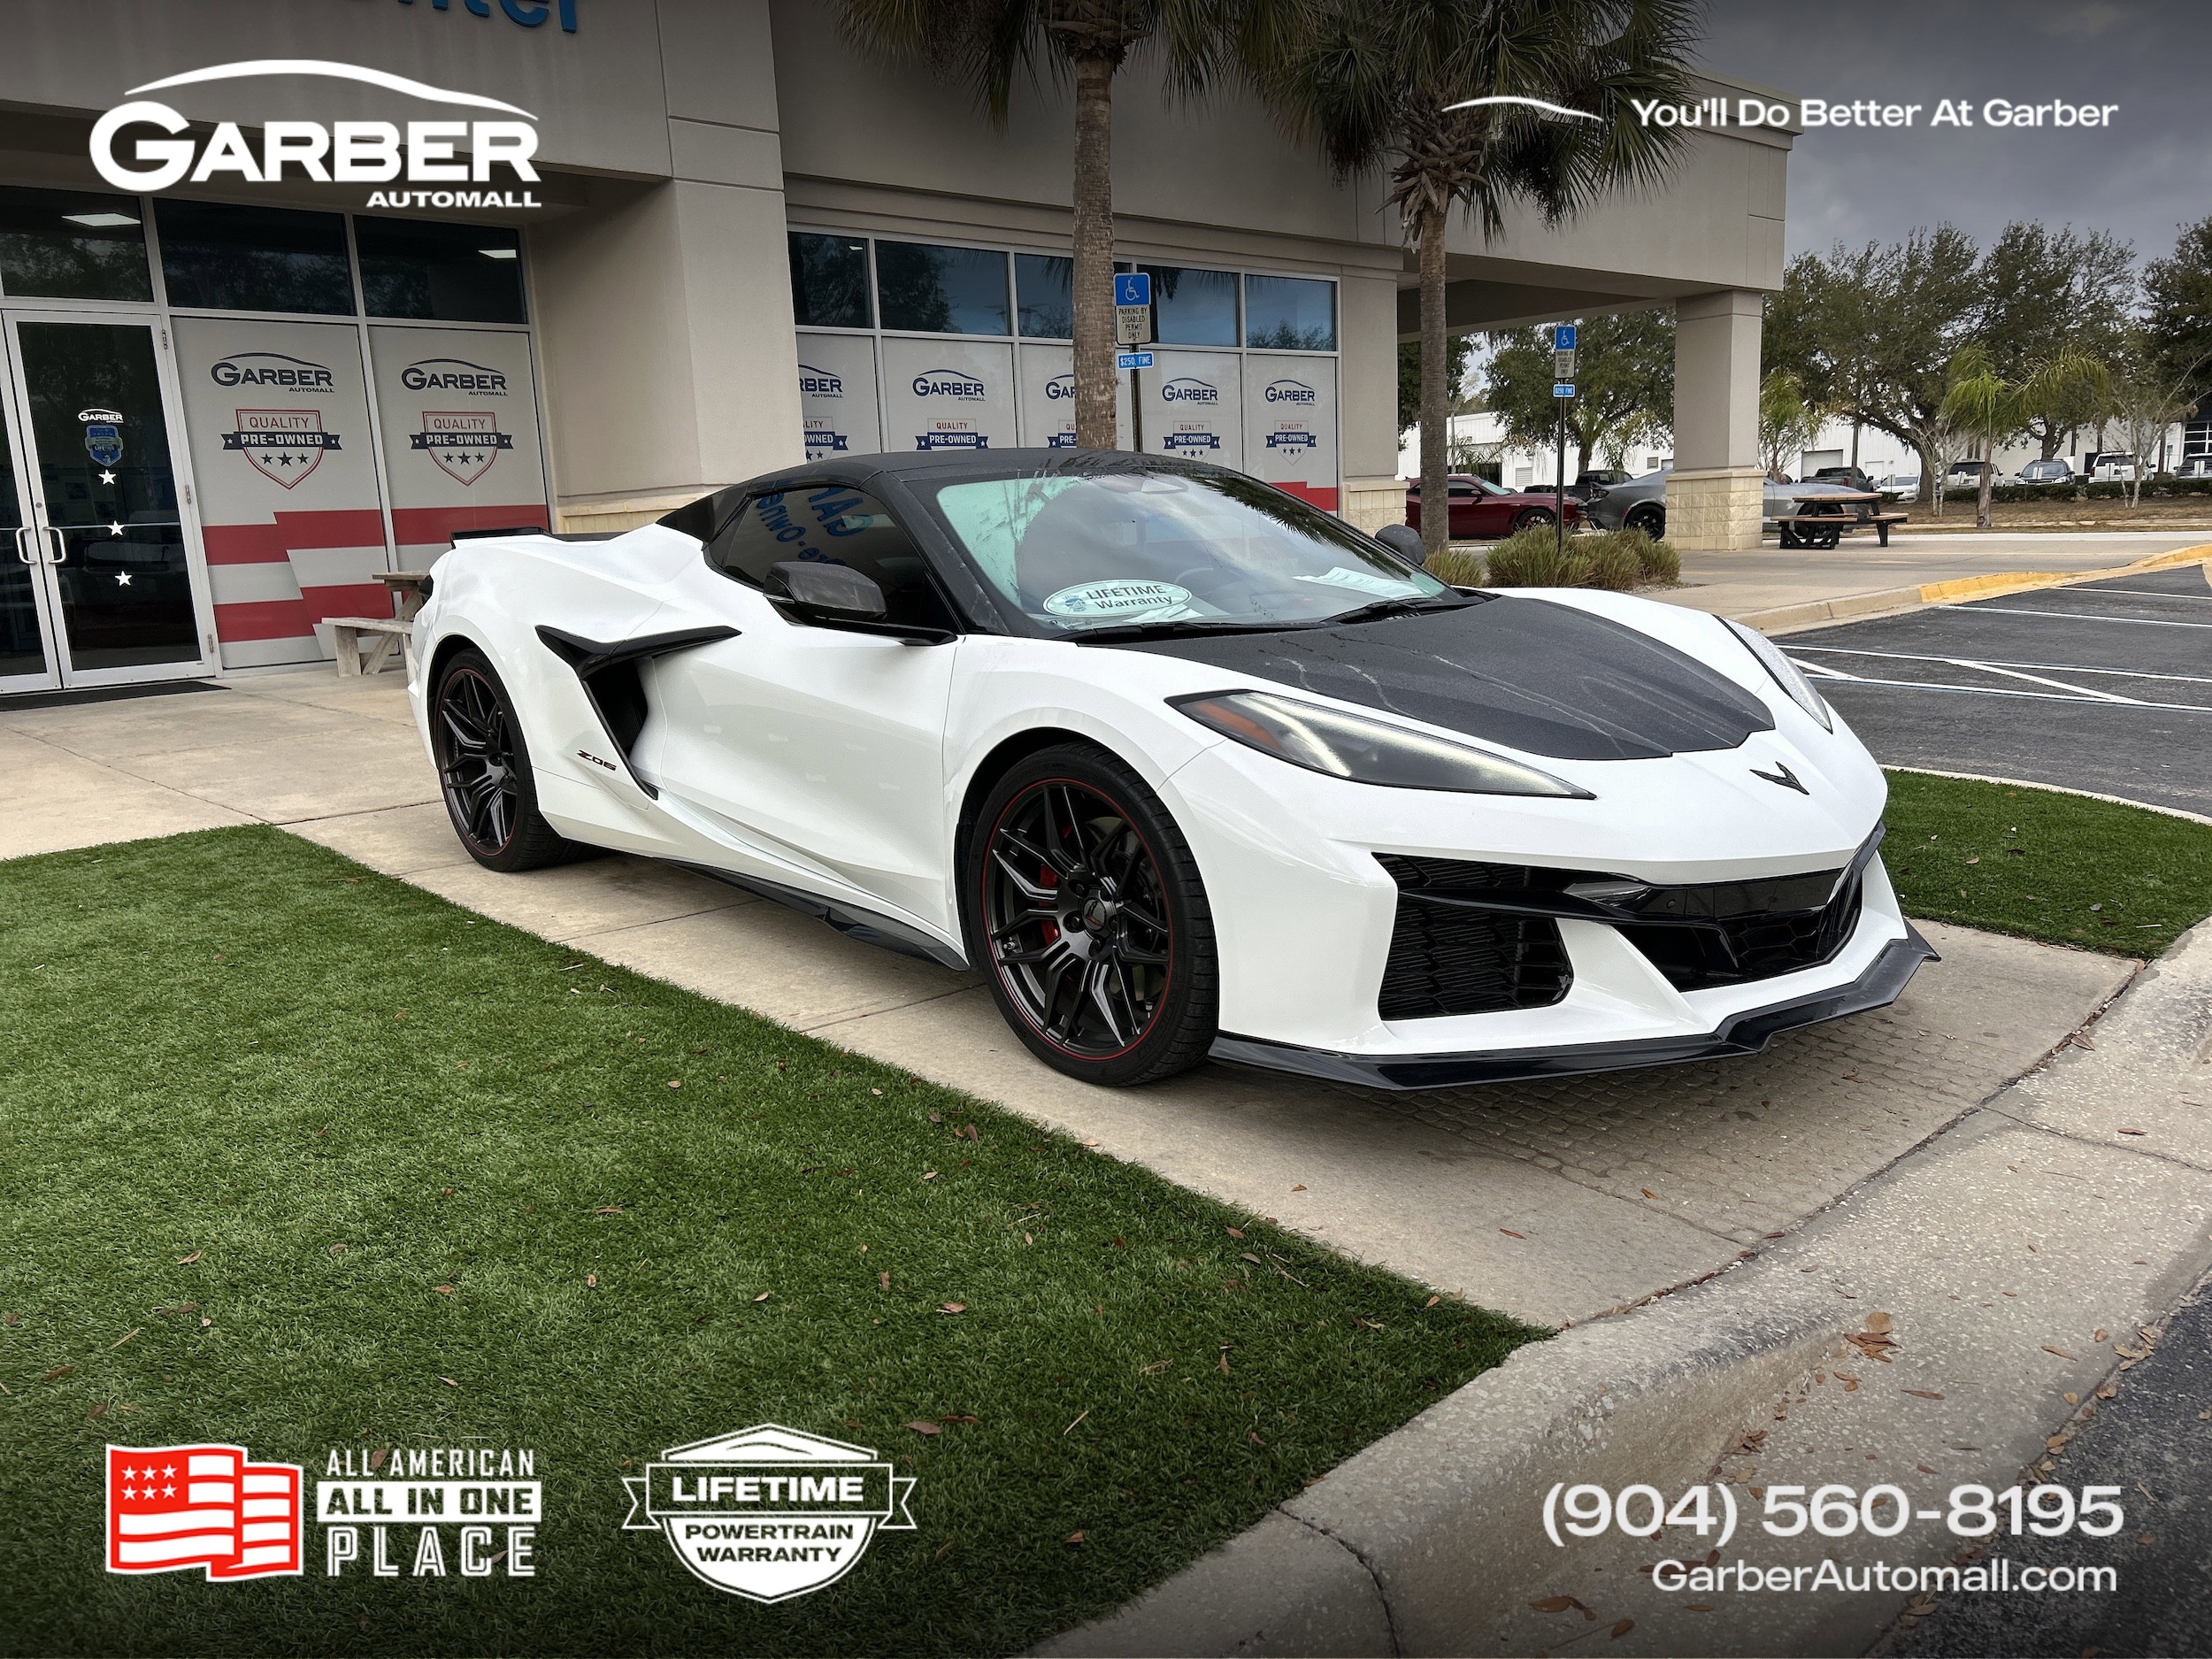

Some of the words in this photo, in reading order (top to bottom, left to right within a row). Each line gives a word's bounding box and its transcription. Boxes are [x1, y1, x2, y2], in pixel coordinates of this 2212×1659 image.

[211, 362, 334, 387] GARBER
[401, 367, 507, 390] GARBER
[799, 378, 842, 392] RBER
[912, 378, 985, 396] GARBER
[1162, 385, 1218, 402] GARBER
[1264, 386, 1316, 402] GARBER
[78, 411, 123, 422] GARBER
[250, 417, 309, 428] QUALITY
[434, 419, 486, 429] QUALITY
[241, 434, 324, 445] PRE-OWNED
[426, 434, 497, 445] PRE-OWNED
[929, 434, 977, 444] PRE-OWNED
[1174, 434, 1211, 443] PRE-OWNED
[1275, 434, 1308, 442] PRE-OWNED
[1086, 584, 1166, 601] LIFETIME
[1094, 595, 1173, 611] Warranty
[576, 749, 617, 772] Z06
